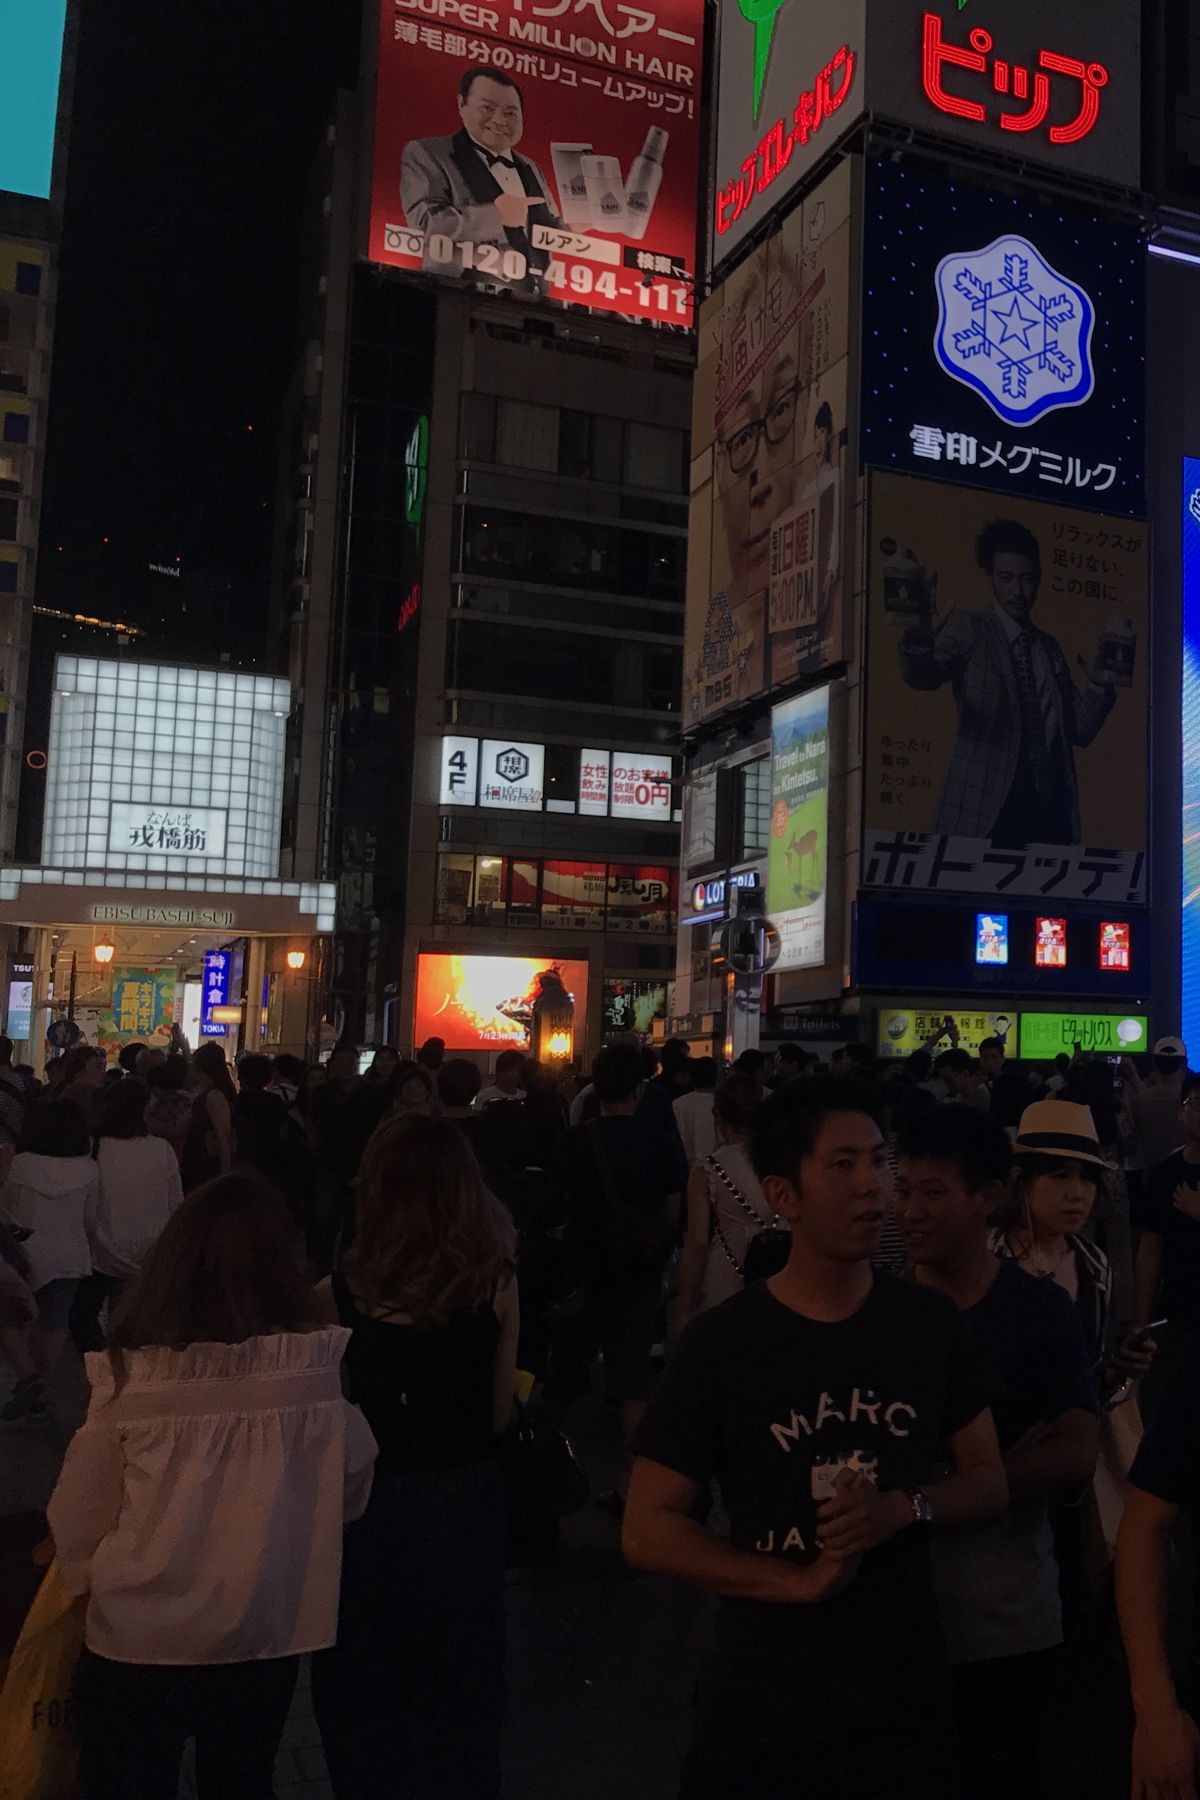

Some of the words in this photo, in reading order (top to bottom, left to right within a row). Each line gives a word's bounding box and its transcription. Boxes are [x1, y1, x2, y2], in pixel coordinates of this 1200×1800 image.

[509, 17, 617, 65] MILLION
[625, 50, 695, 87] HAIR
[922, 12, 1110, 145] ピップ
[716, 45, 856, 234] ピップエレキバン
[539, 233, 591, 252] ルアン
[429, 234, 688, 315] 0120-494-111
[909, 423, 1117, 491] 雪印メグミルク
[1052, 522, 1142, 553] リラックスが
[146, 810, 192, 828] なんば
[129, 826, 206, 852] 戎橋筋
[706, 872, 756, 904] LOTERIA
[208, 953, 226, 1020] 時計倉
[202, 1024, 225, 1033] TOKIA
[915, 1015, 986, 1030] 店舗報館
[769, 1387, 918, 1453] MARC
[756, 1526, 825, 1552] JA
